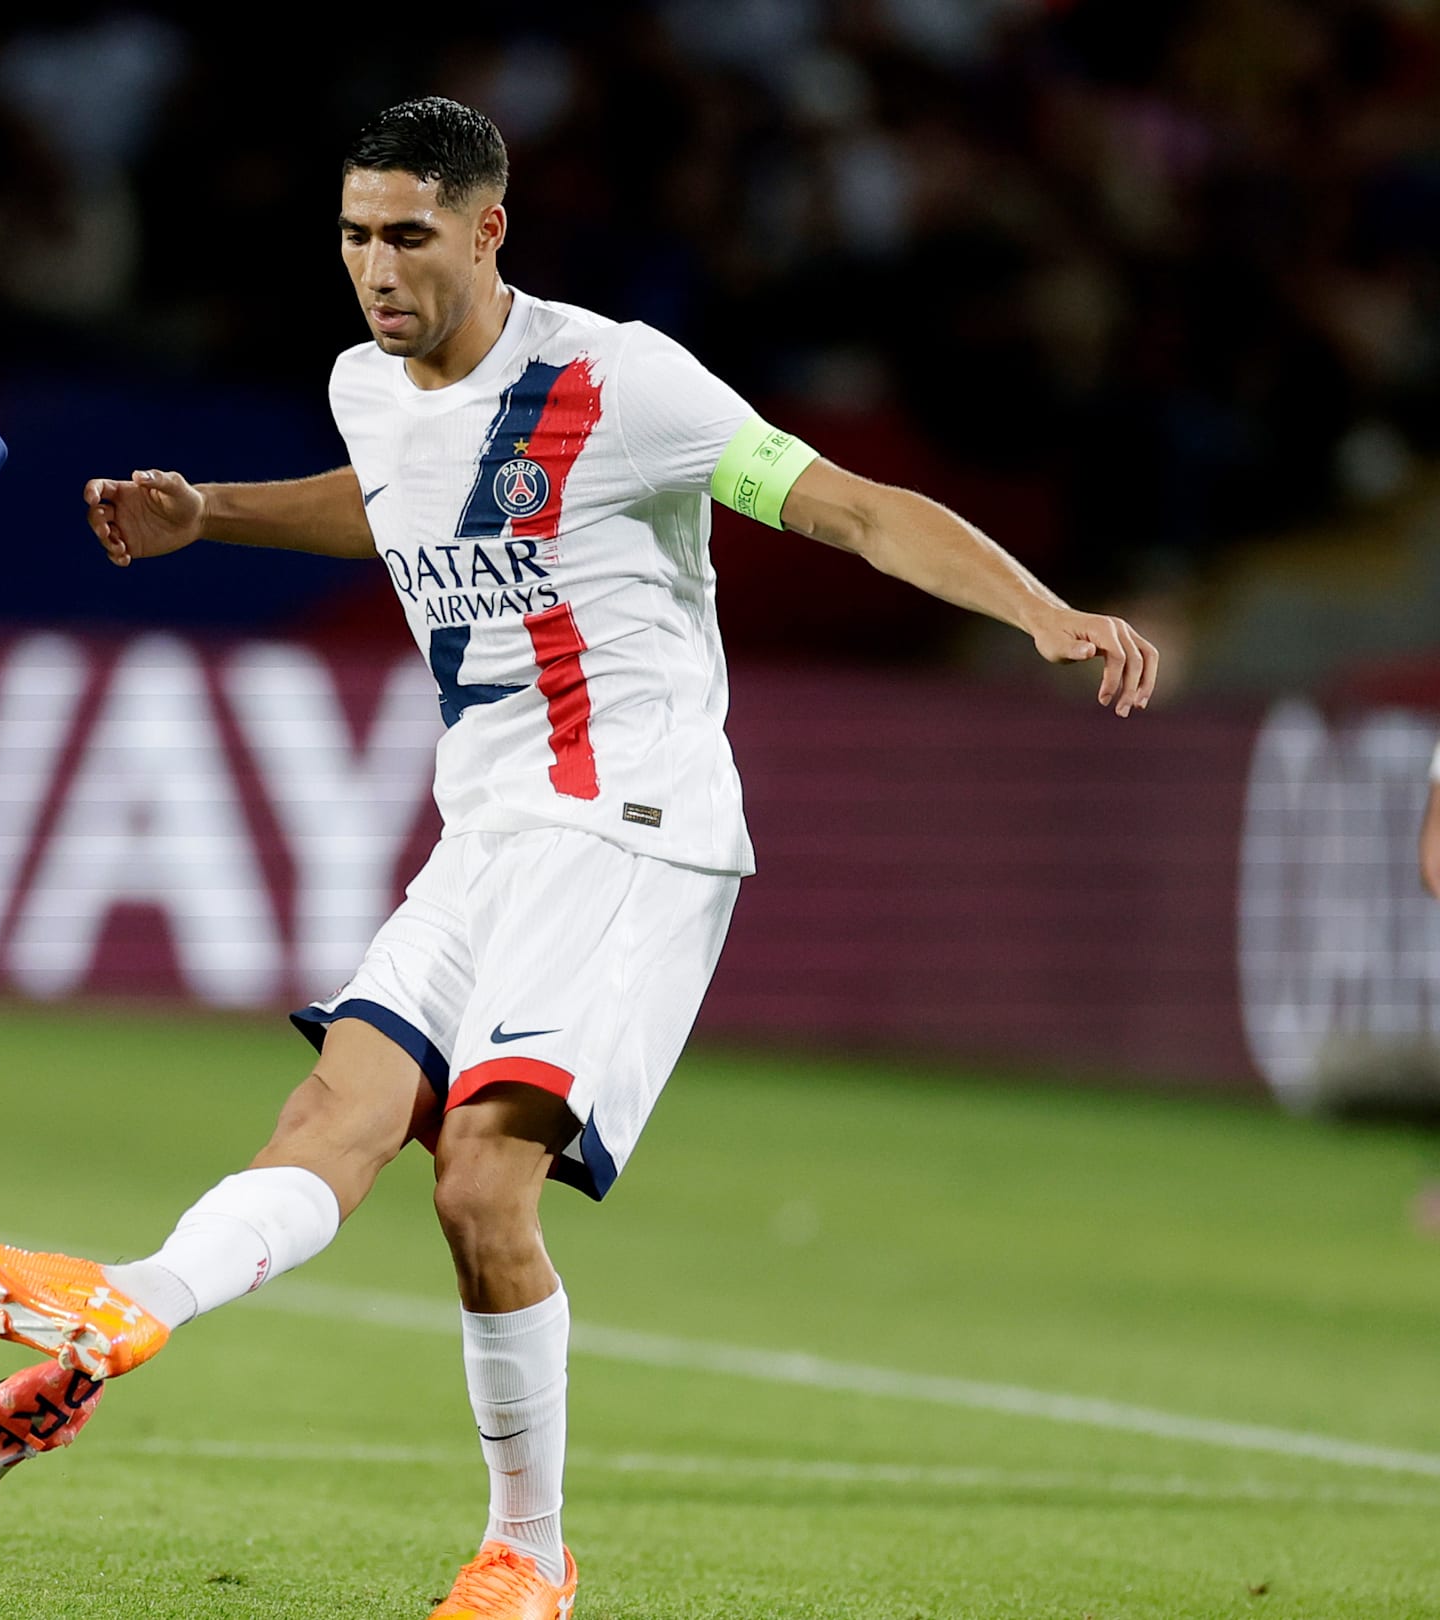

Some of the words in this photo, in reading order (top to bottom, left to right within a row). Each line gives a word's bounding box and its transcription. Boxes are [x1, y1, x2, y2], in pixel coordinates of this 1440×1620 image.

[502, 462, 538, 477] PARIS
[385, 540, 550, 602] QATAR
[426, 583, 558, 625] AIRWAYS
